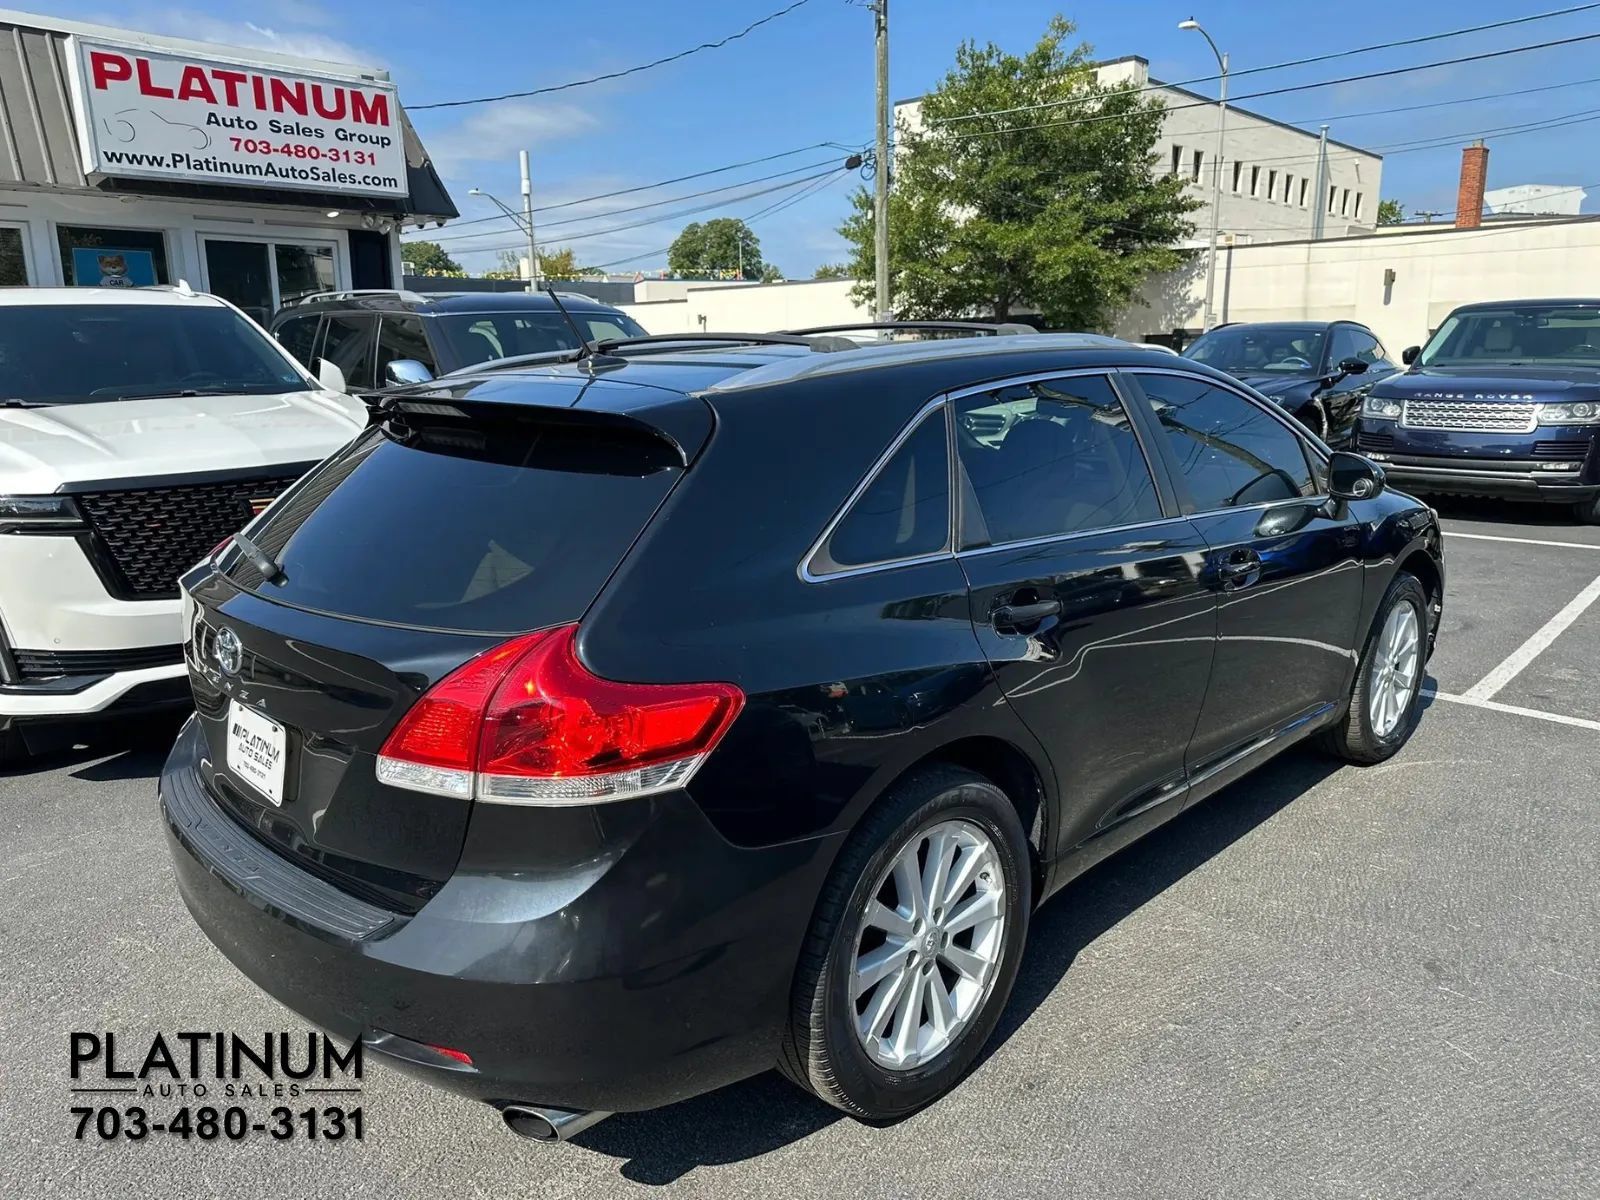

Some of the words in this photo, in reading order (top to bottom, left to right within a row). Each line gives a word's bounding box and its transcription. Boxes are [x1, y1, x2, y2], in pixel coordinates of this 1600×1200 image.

[90, 51, 390, 127] PLATINUM
[206, 112, 258, 131] Auto
[268, 119, 325, 139] Sales
[334, 128, 392, 148] Group
[229, 137, 376, 166] 703-480-3131
[103, 150, 398, 189] www.PlatinumAutoSales.com
[238, 742, 254, 758] AUTO
[253, 752, 273, 770] SALES
[240, 728, 280, 763] PLATINUM
